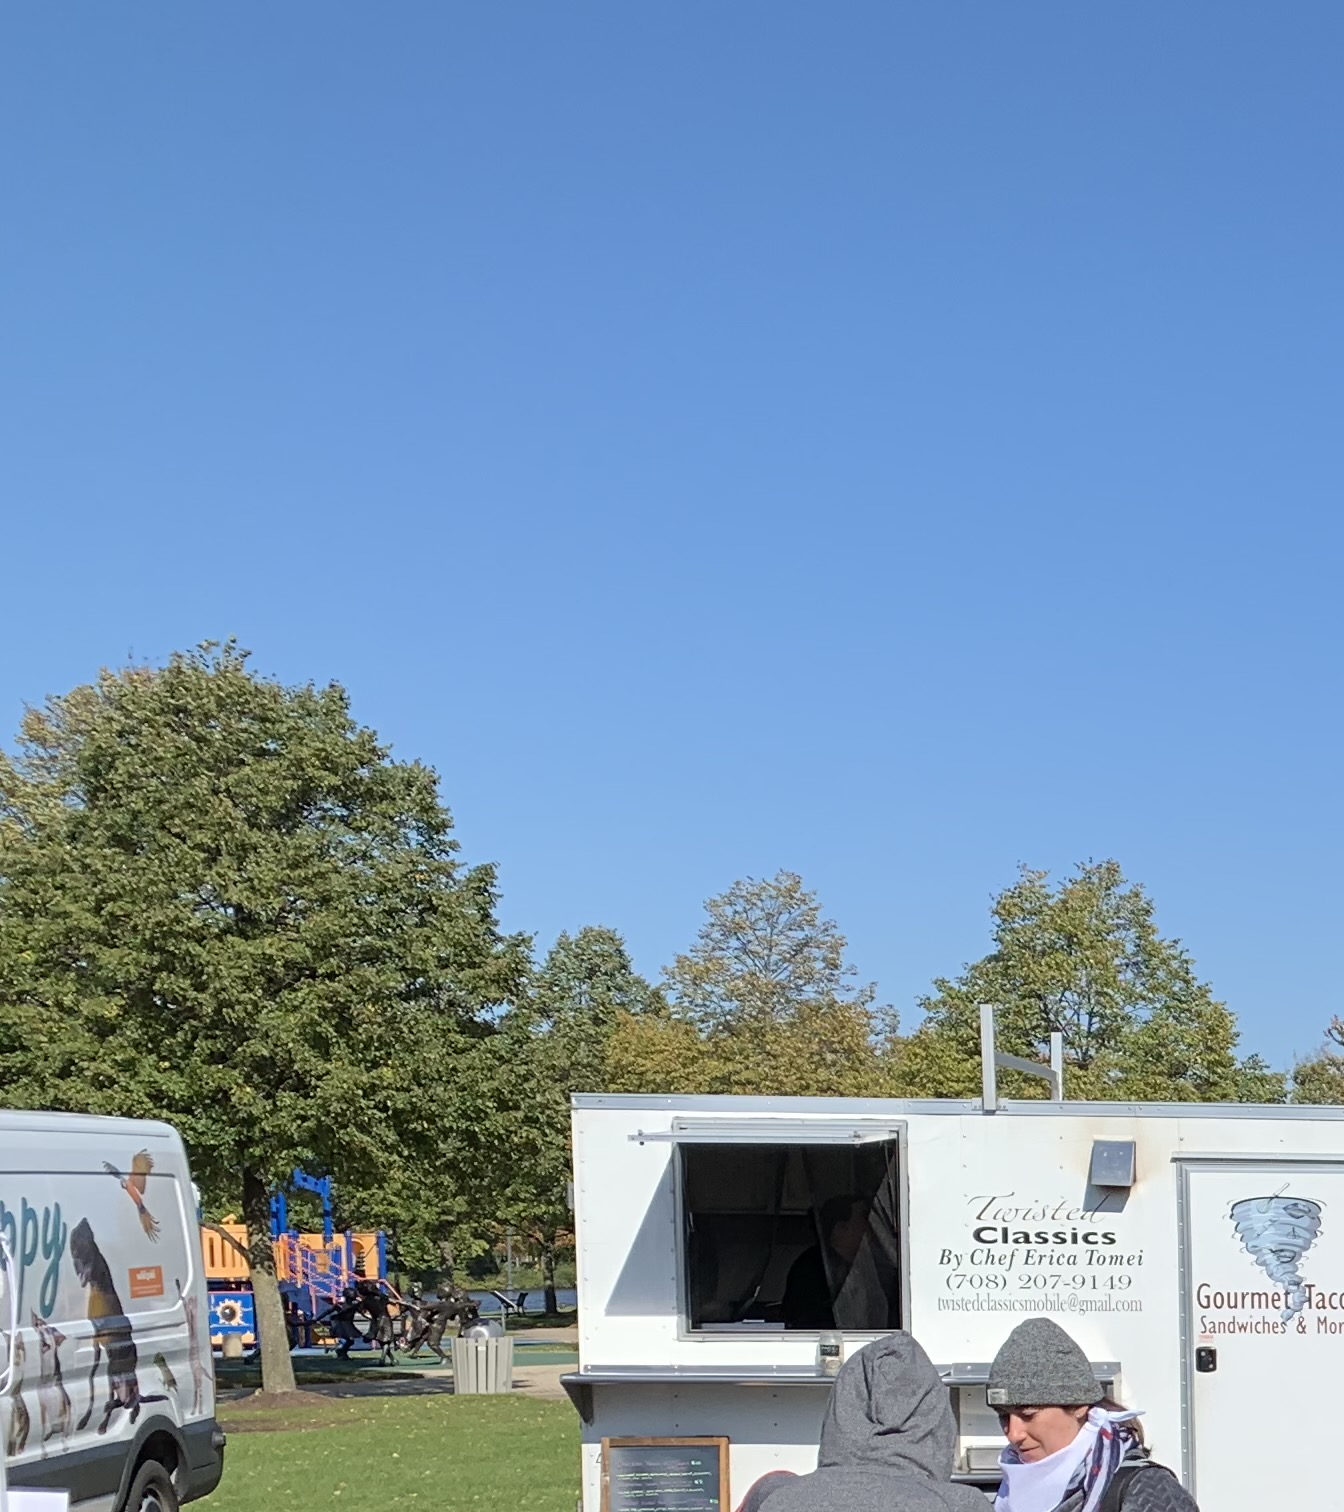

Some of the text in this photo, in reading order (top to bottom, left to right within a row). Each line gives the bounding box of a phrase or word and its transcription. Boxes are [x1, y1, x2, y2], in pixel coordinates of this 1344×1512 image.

[967, 1190, 1114, 1223] Twisted
[972, 1226, 1117, 1246] Classics
[938, 1248, 1144, 1272] By Chef Erica Tomei
[945, 1273, 1132, 1292] (708) 207-9149
[937, 1292, 1143, 1316] twistedclassicsmobile@gmail.com
[1196, 1283, 1291, 1310] Gourmet
[1200, 1315, 1288, 1334] Sandwiches
[1296, 1315, 1307, 1334] &
